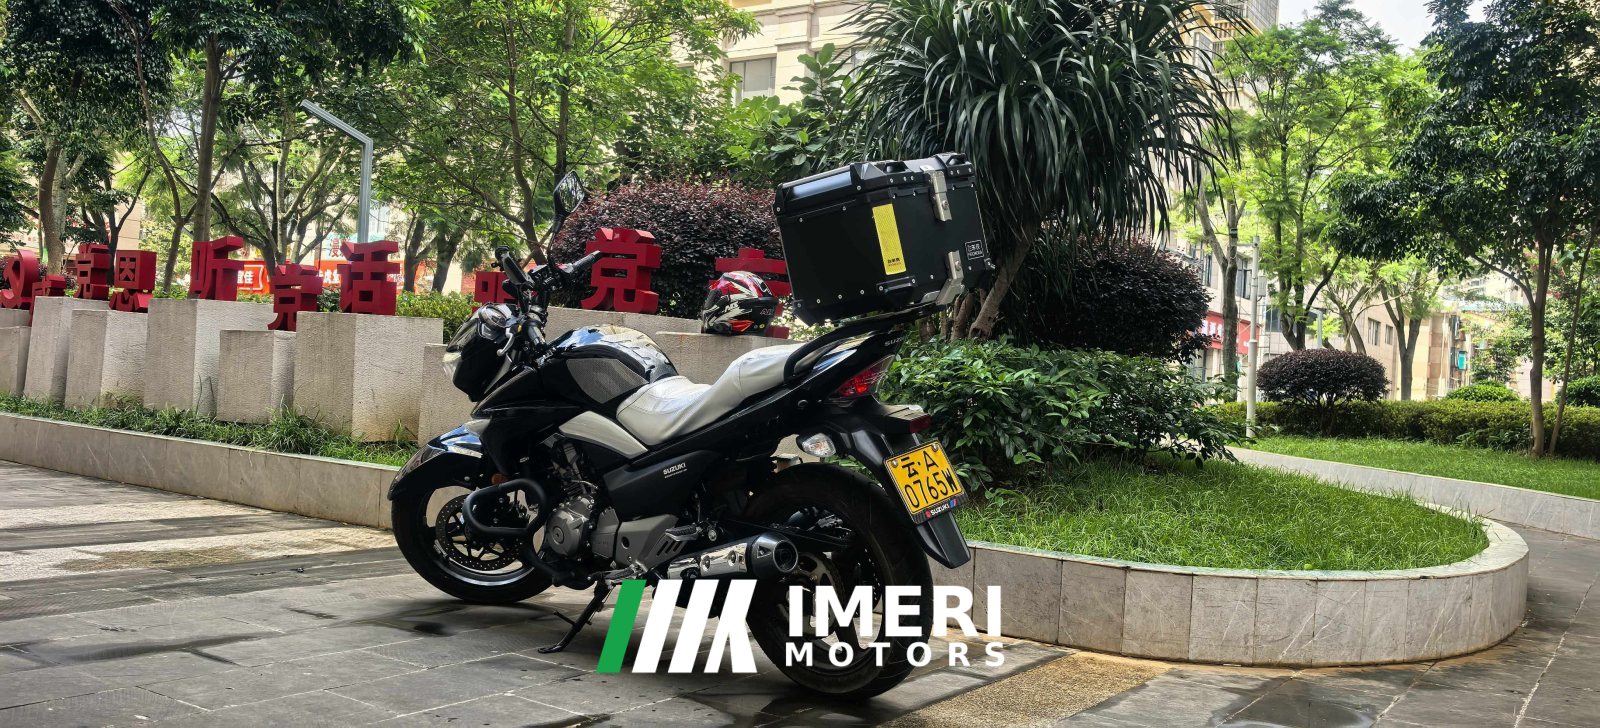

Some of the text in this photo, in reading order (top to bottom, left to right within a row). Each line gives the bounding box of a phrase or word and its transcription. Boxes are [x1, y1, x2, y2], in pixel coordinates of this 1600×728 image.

[663, 462, 687, 475] SUZUKI
[904, 468, 956, 507] 0765W
[930, 504, 950, 516] SUZUKI
